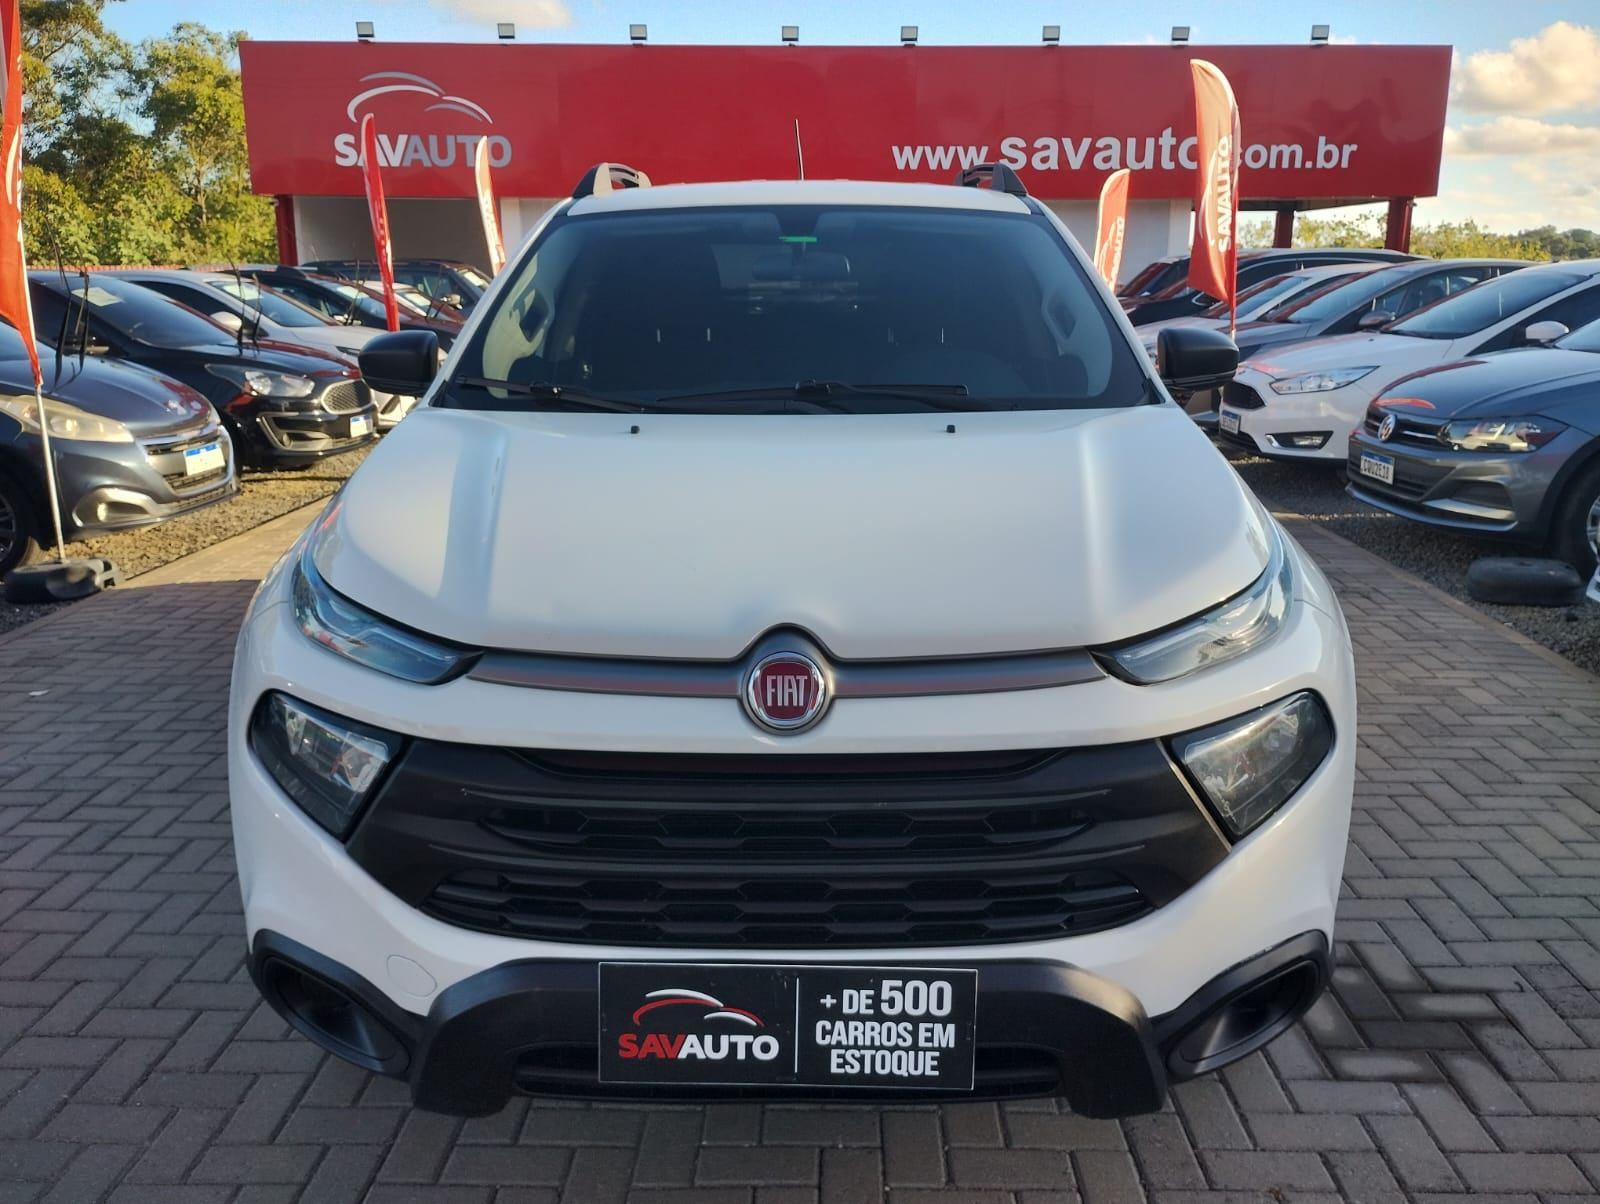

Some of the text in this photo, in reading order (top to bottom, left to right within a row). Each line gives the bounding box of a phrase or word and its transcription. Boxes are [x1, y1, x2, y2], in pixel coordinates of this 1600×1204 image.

[1217, 135, 1232, 253] SAVAUTO
[766, 675, 808, 707] FIAT
[843, 989, 874, 1014] DE
[881, 980, 952, 1017] 500
[618, 1033, 779, 1061] SAVAUTO
[816, 1020, 955, 1049] CARROS EM
[830, 1049, 940, 1077] ESTOQUE
